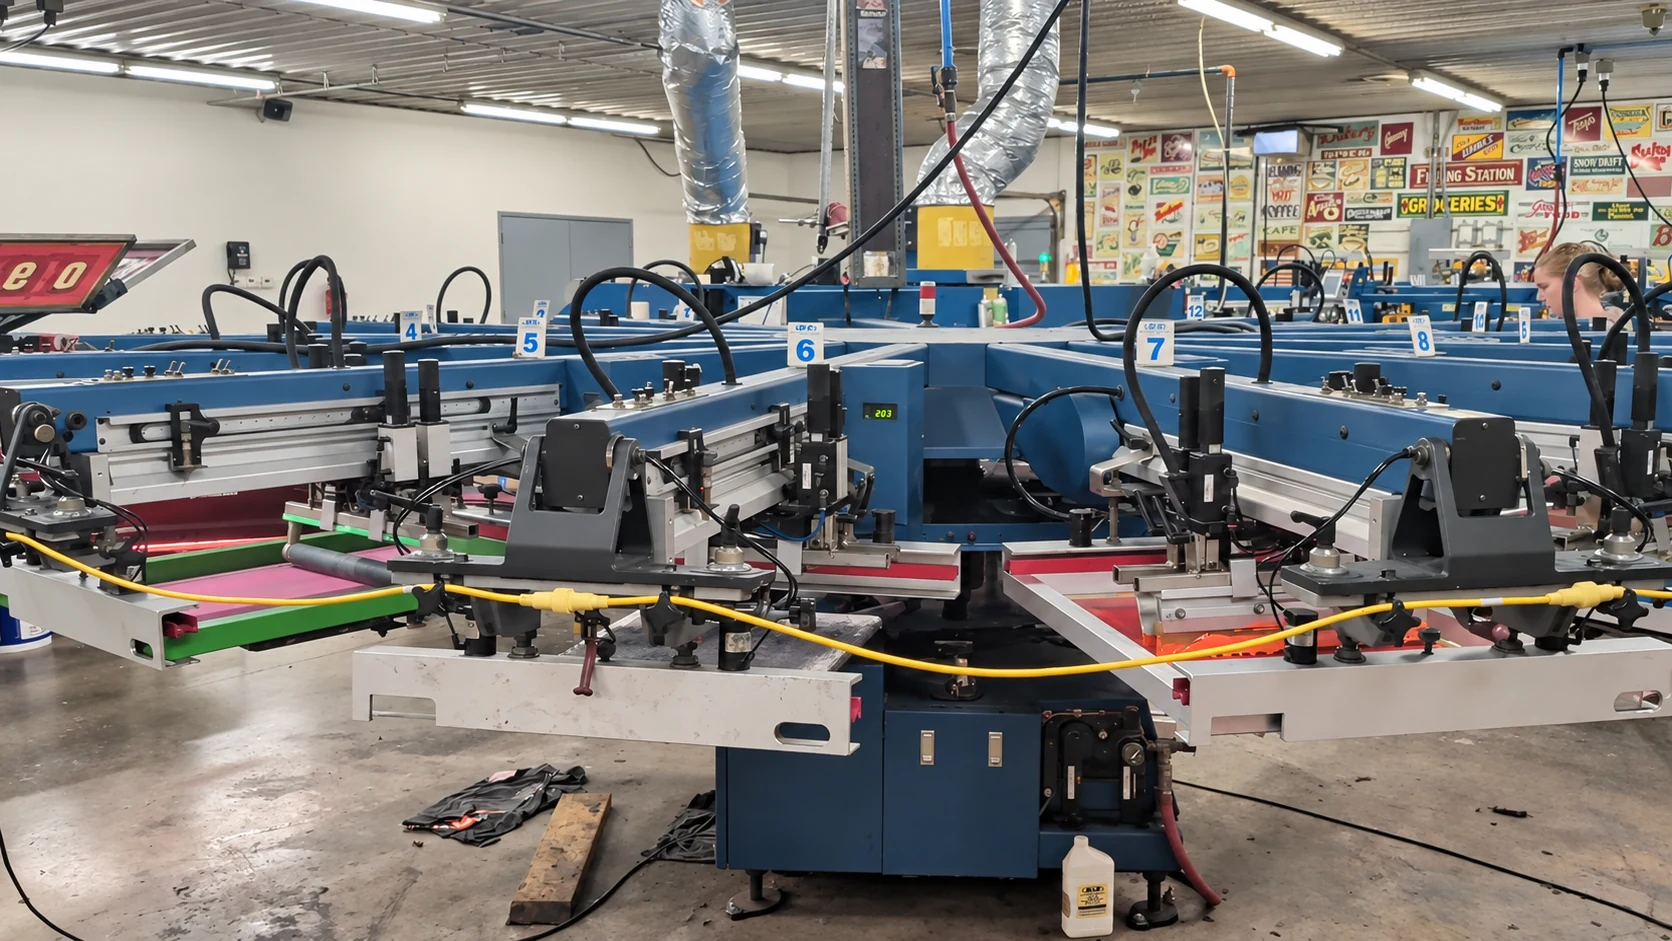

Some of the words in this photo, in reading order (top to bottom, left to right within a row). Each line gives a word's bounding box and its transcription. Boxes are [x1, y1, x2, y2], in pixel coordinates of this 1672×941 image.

[1465, 166, 1515, 182] STATION
[1188, 305, 1203, 317] 12
[1348, 309, 1361, 322] 11
[406, 323, 417, 340] 4
[523, 333, 538, 353] 5
[1147, 337, 1165, 360] 7
[1417, 331, 1430, 351] 8
[796, 339, 815, 362] 6
[875, 409, 892, 418] 203
